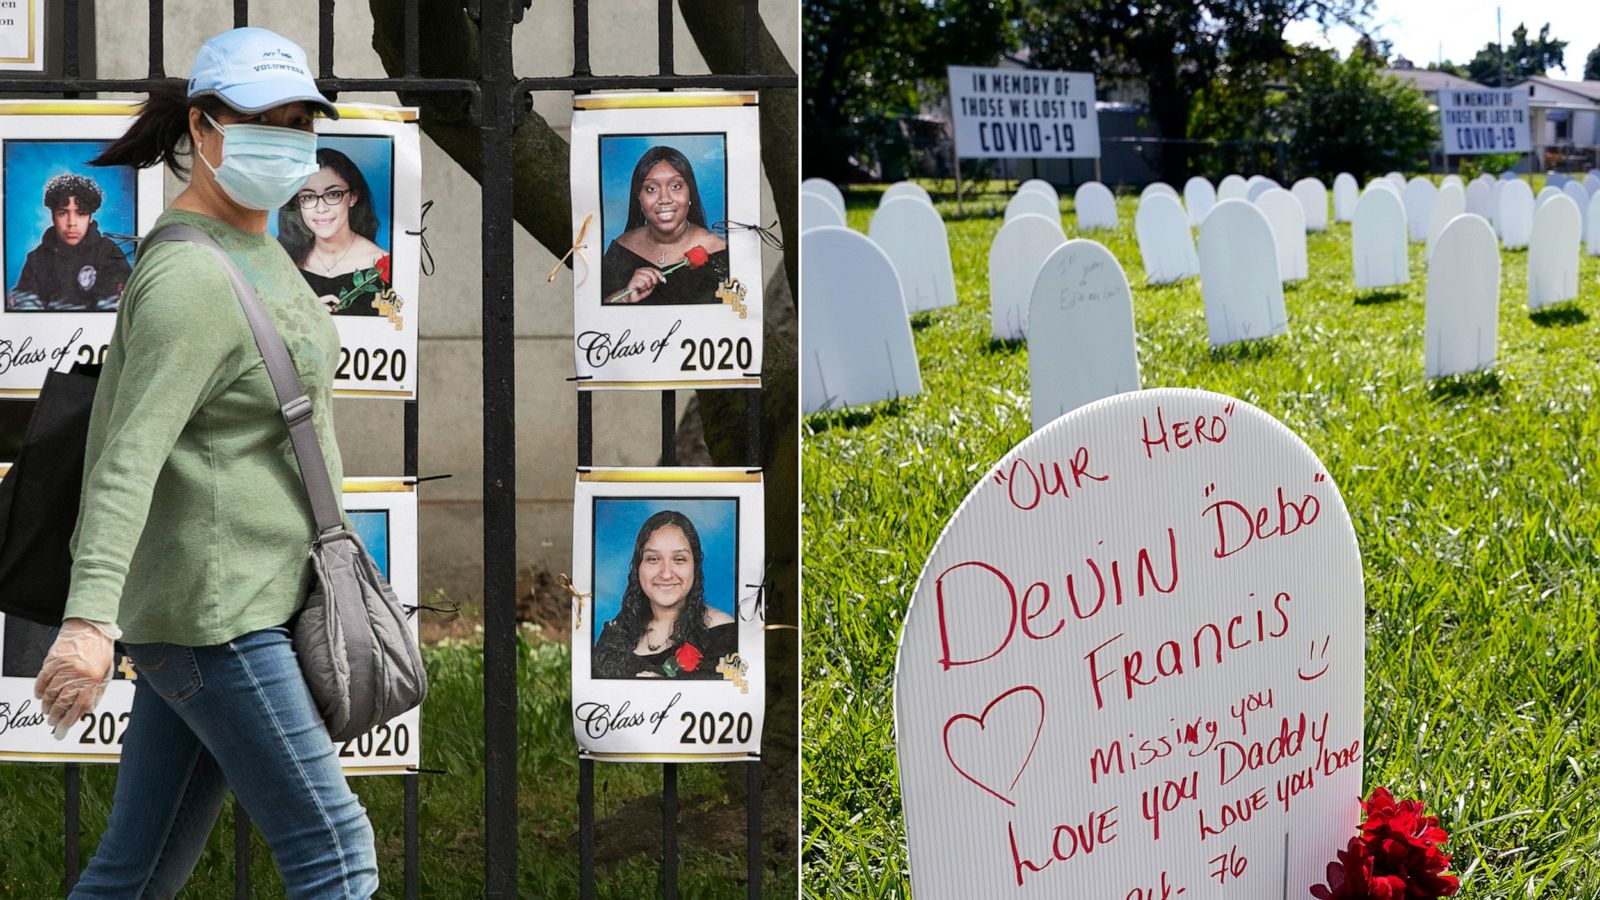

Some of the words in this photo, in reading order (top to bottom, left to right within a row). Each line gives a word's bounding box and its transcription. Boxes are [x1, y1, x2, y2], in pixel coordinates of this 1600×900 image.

[973, 74, 987, 92] IN
[993, 75, 1050, 95] MEMORY
[1054, 77, 1070, 96] OF
[961, 97, 1004, 117] THOSE
[1010, 99, 1029, 118] WE
[1035, 100, 1066, 119] LOST
[1072, 101, 1087, 119] TO
[979, 122, 1075, 152] COVID-19
[1456, 127, 1516, 149] COVID-19
[51, 327, 84, 371] of
[577, 329, 646, 368] Class
[650, 319, 682, 363] of
[680, 337, 752, 371] 2020
[334, 347, 407, 382] 2020
[79, 711, 130, 745] 202
[575, 700, 645, 739] Class
[650, 692, 682, 735] of
[680, 711, 753, 745] 2020
[1214, 712, 1329, 786] Daddy
[1324, 740, 1361, 777] bae
[1209, 845, 1248, 885] 76
